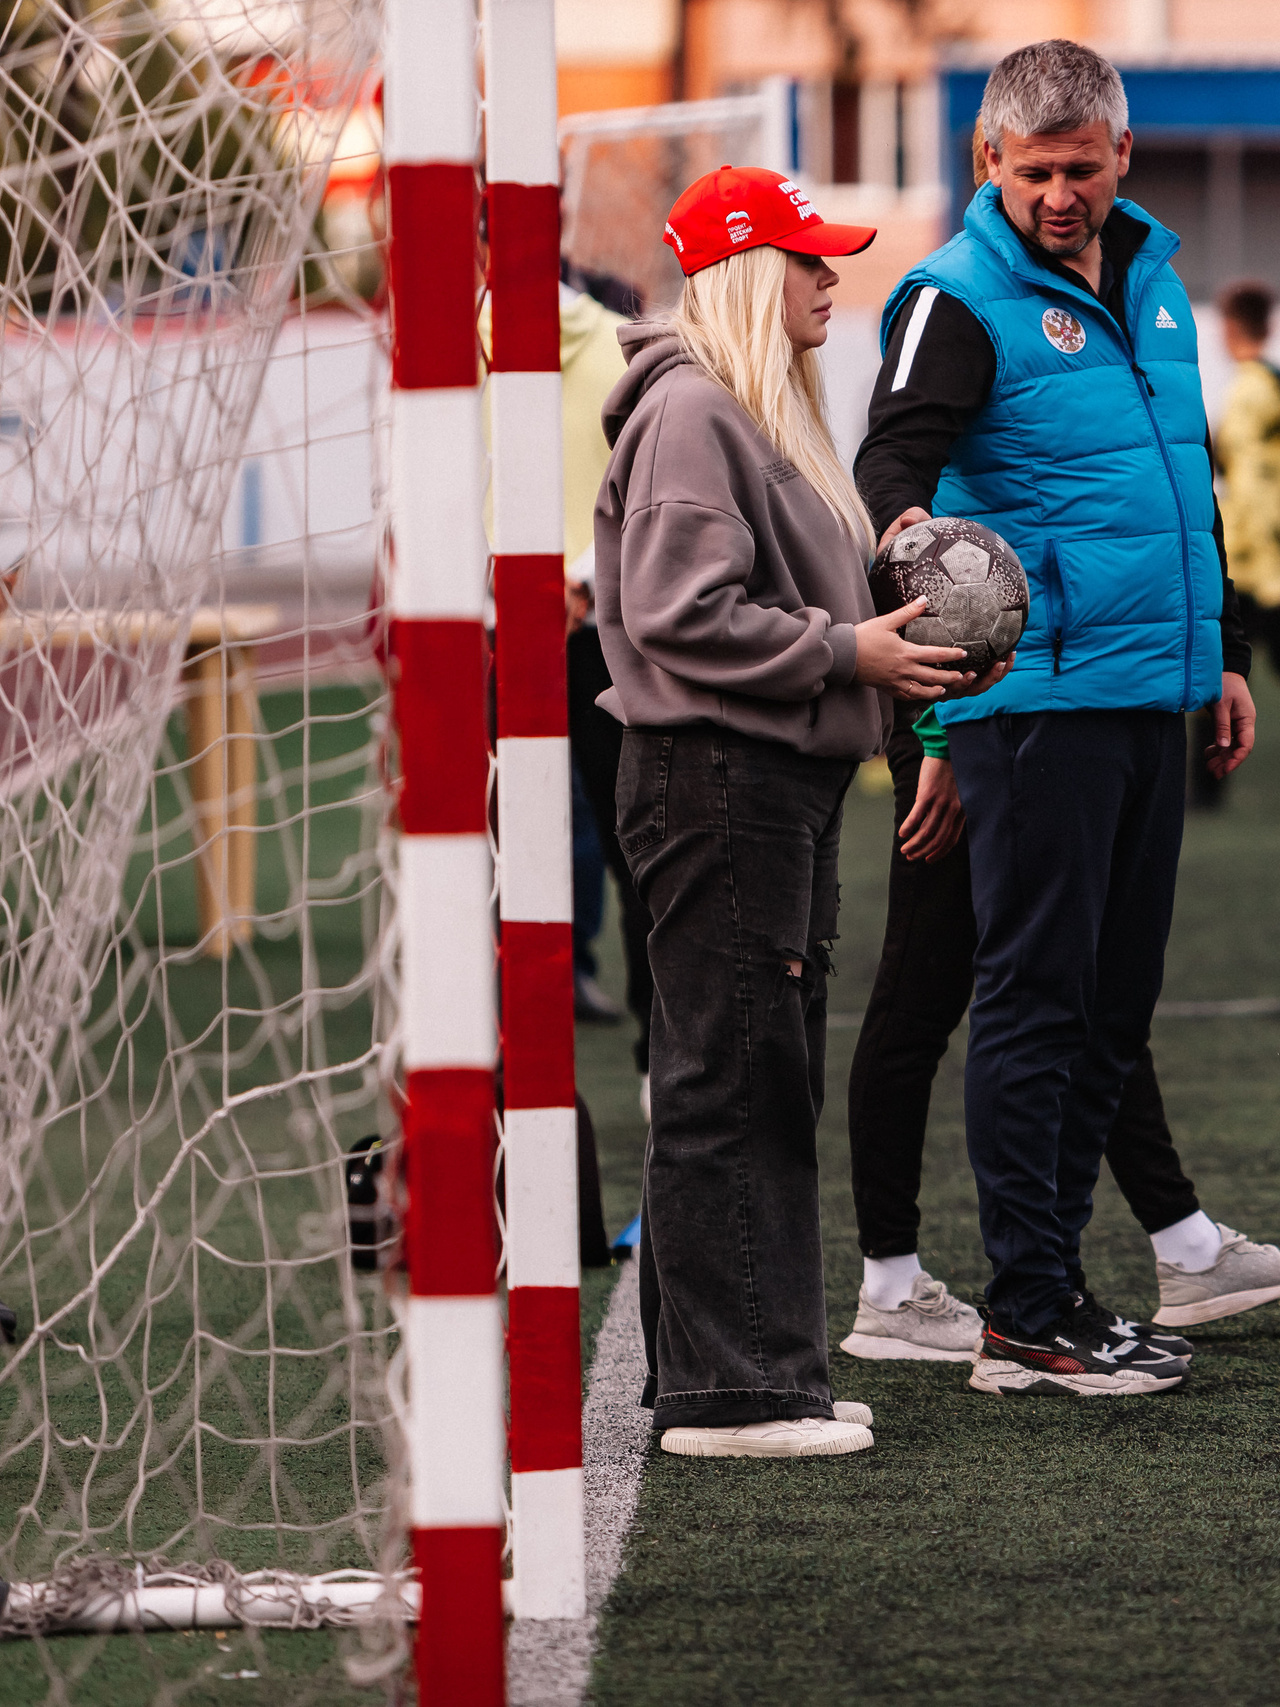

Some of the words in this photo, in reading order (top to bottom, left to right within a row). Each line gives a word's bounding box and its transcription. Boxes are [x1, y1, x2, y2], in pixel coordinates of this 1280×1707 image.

[789, 194, 799, 206] С
[727, 222, 746, 233] ПРОЕКТ
[730, 225, 753, 240] ДЕТСКИЙ
[731, 234, 749, 244] СПОРТ
[1155, 320, 1178, 329] adidas
